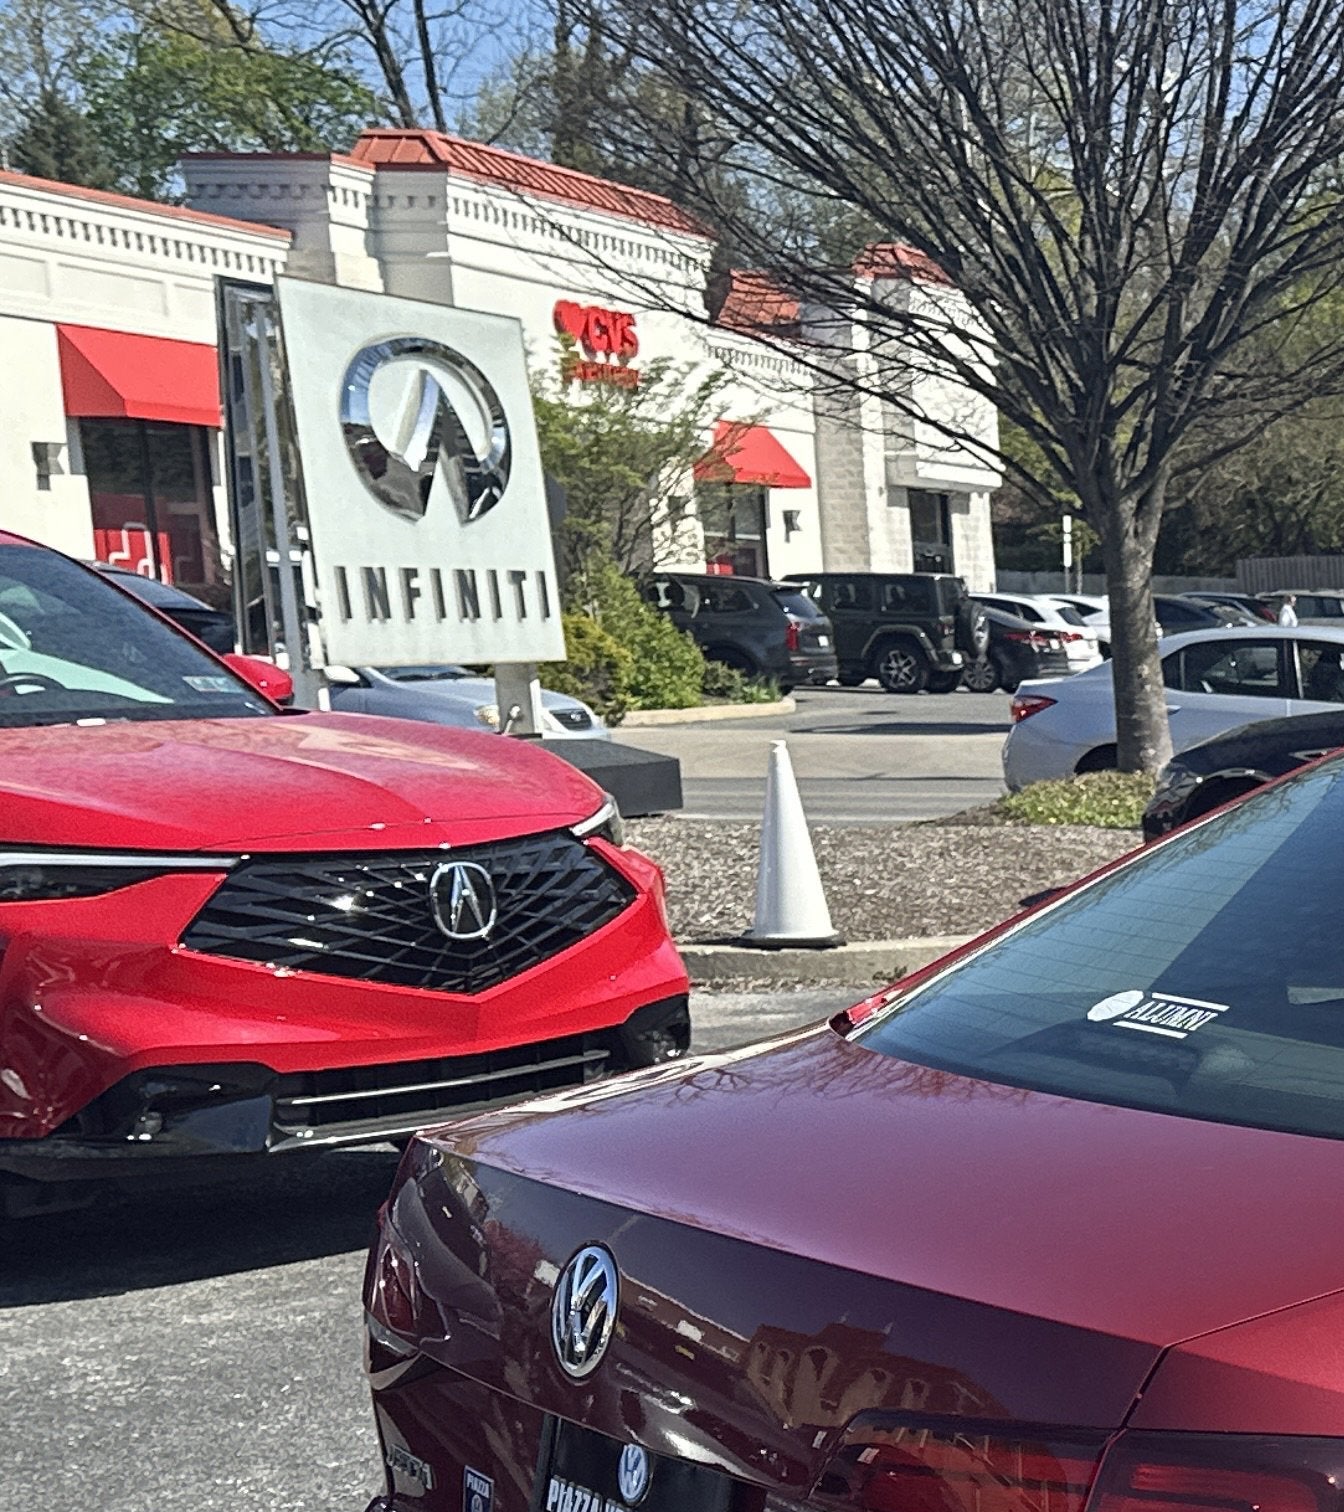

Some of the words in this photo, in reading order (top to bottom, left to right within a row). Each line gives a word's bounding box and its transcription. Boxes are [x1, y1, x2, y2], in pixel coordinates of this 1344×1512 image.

[582, 305, 639, 360] CVS
[333, 566, 551, 622] INFINITI
[1123, 1000, 1219, 1032] ALUMNI
